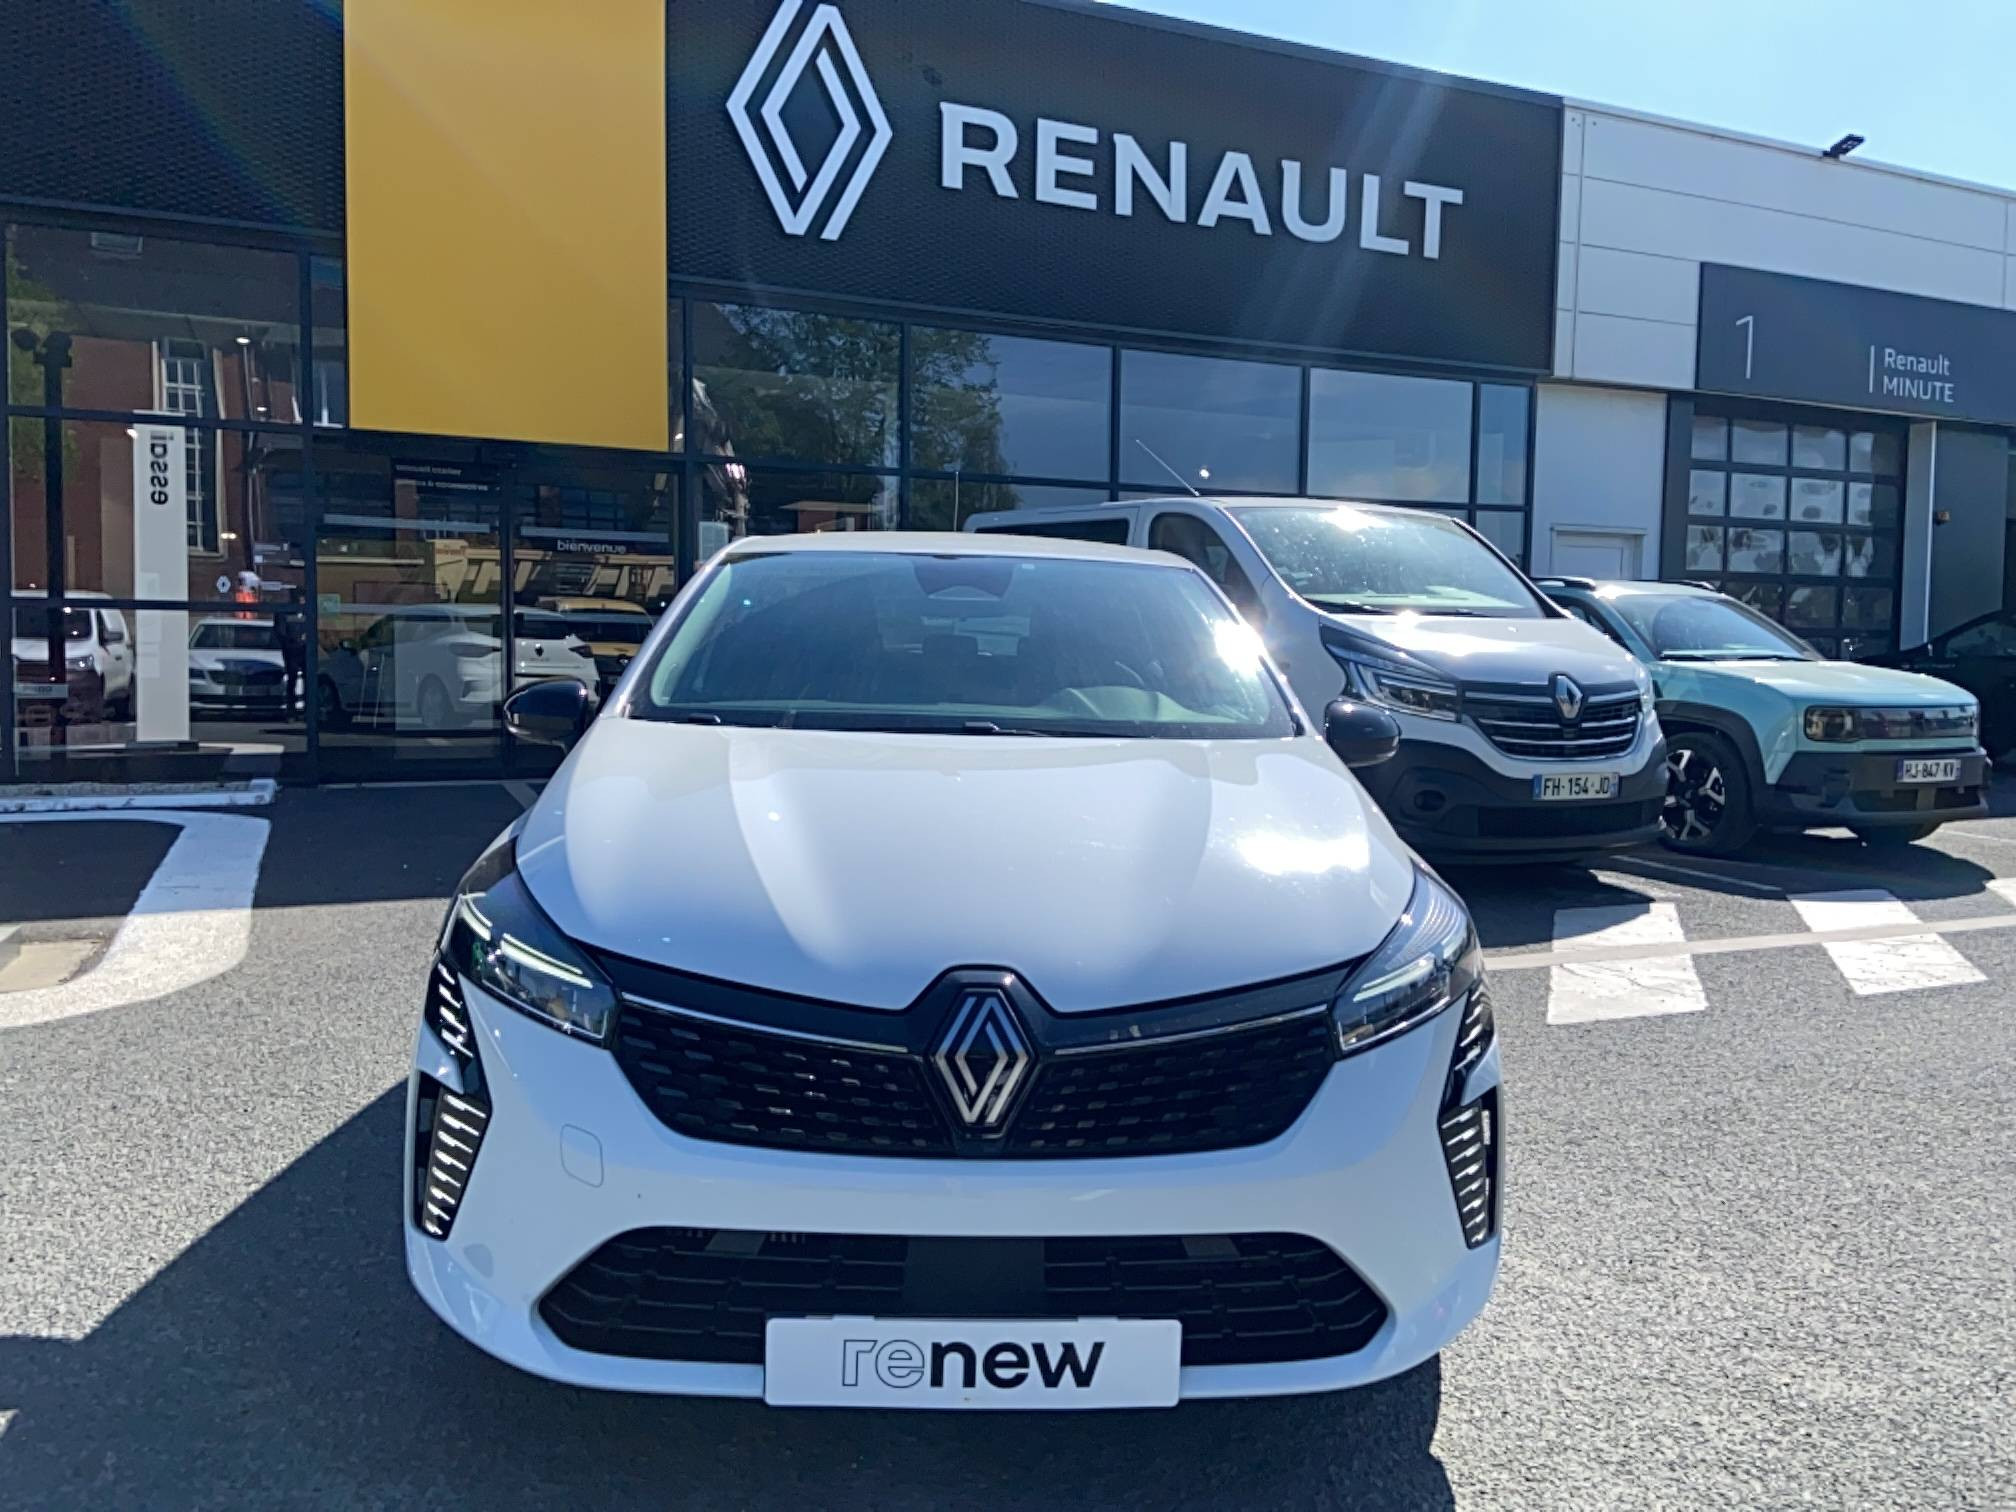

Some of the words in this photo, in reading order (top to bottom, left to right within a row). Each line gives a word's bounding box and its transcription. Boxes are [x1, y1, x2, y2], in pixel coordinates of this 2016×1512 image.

[939, 101, 1464, 260] RENAULT
[1735, 315, 1754, 379] 1
[1883, 347, 1951, 376] Renault
[1882, 375, 1955, 403] MINUTE
[557, 539, 627, 554] bienvenue
[841, 1339, 1105, 1389] renew
